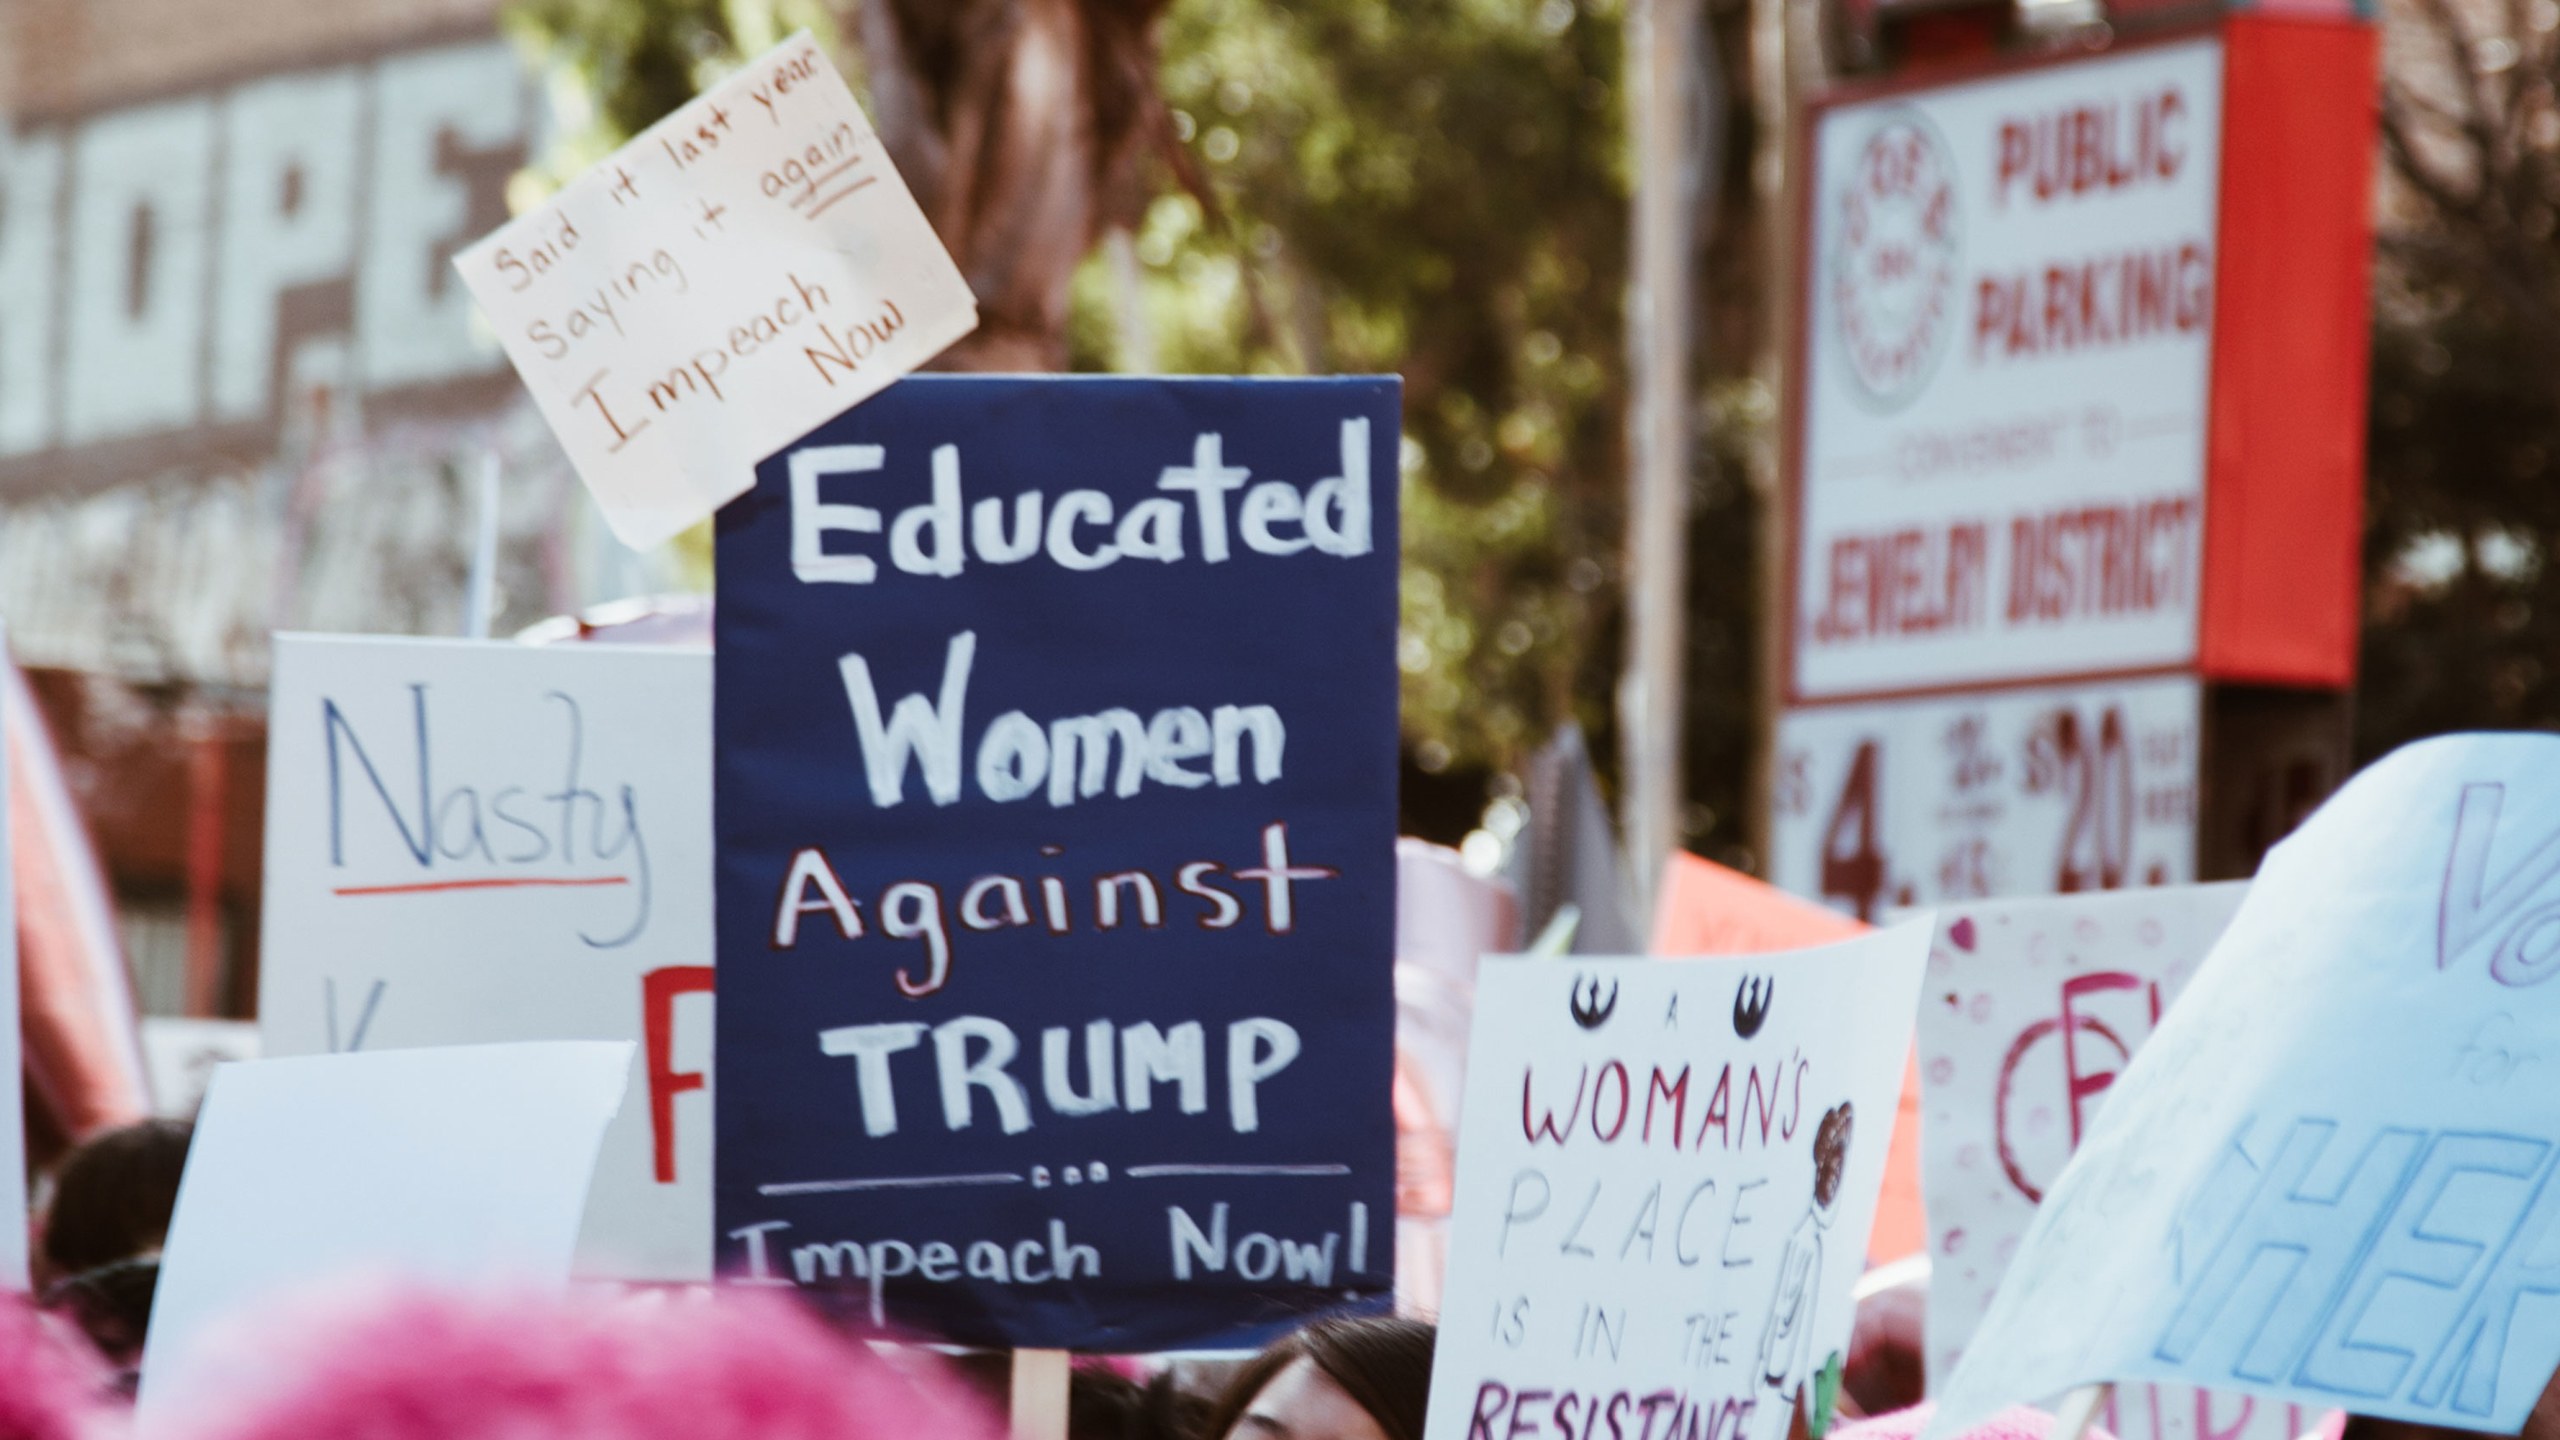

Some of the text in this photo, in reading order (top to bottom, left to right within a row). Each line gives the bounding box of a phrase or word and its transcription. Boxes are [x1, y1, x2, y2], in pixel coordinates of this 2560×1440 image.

[494, 47, 818, 292] Said it last year
[1996, 86, 2186, 206] PUBLIC
[526, 247, 690, 361] Saying
[684, 198, 728, 240] it
[1972, 242, 2209, 358] PARKING
[571, 272, 905, 455] Impeach Now
[788, 416, 1374, 584] Educated
[2004, 494, 2200, 625] DISTRICT
[838, 630, 1287, 808] Women
[321, 683, 652, 949] Nasty
[770, 822, 1340, 996] Against
[1665, 992, 1680, 1028] A
[818, 1016, 1302, 1137] TRUMP
[1522, 1048, 1808, 1151] WOMAN'S
[729, 1202, 1369, 1328] Impeach Now!
[1500, 1168, 1768, 1266] PLACE
[1492, 1297, 1739, 1366] IS IN THE
